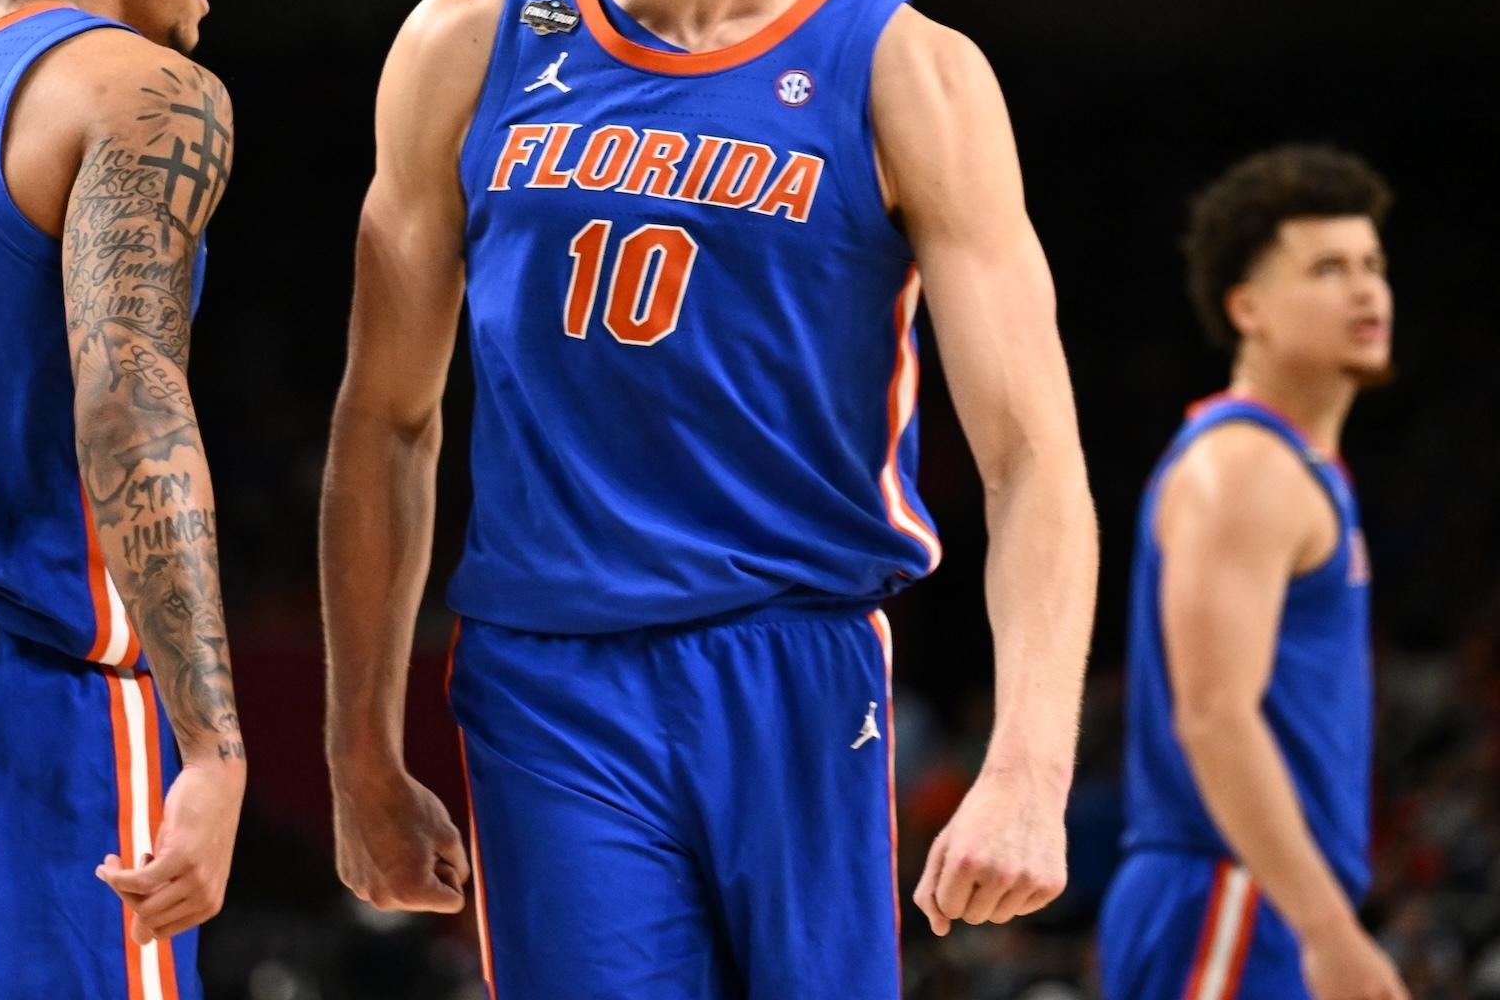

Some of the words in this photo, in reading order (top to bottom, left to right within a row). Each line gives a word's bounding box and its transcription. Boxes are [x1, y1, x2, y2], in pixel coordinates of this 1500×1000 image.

[524, 5, 551, 19] FINAL
[550, 12, 577, 25] FOUR
[779, 73, 812, 104] SEC
[487, 122, 825, 223] FLORIDA
[563, 219, 699, 347] 10
[126, 472, 190, 521] STAY
